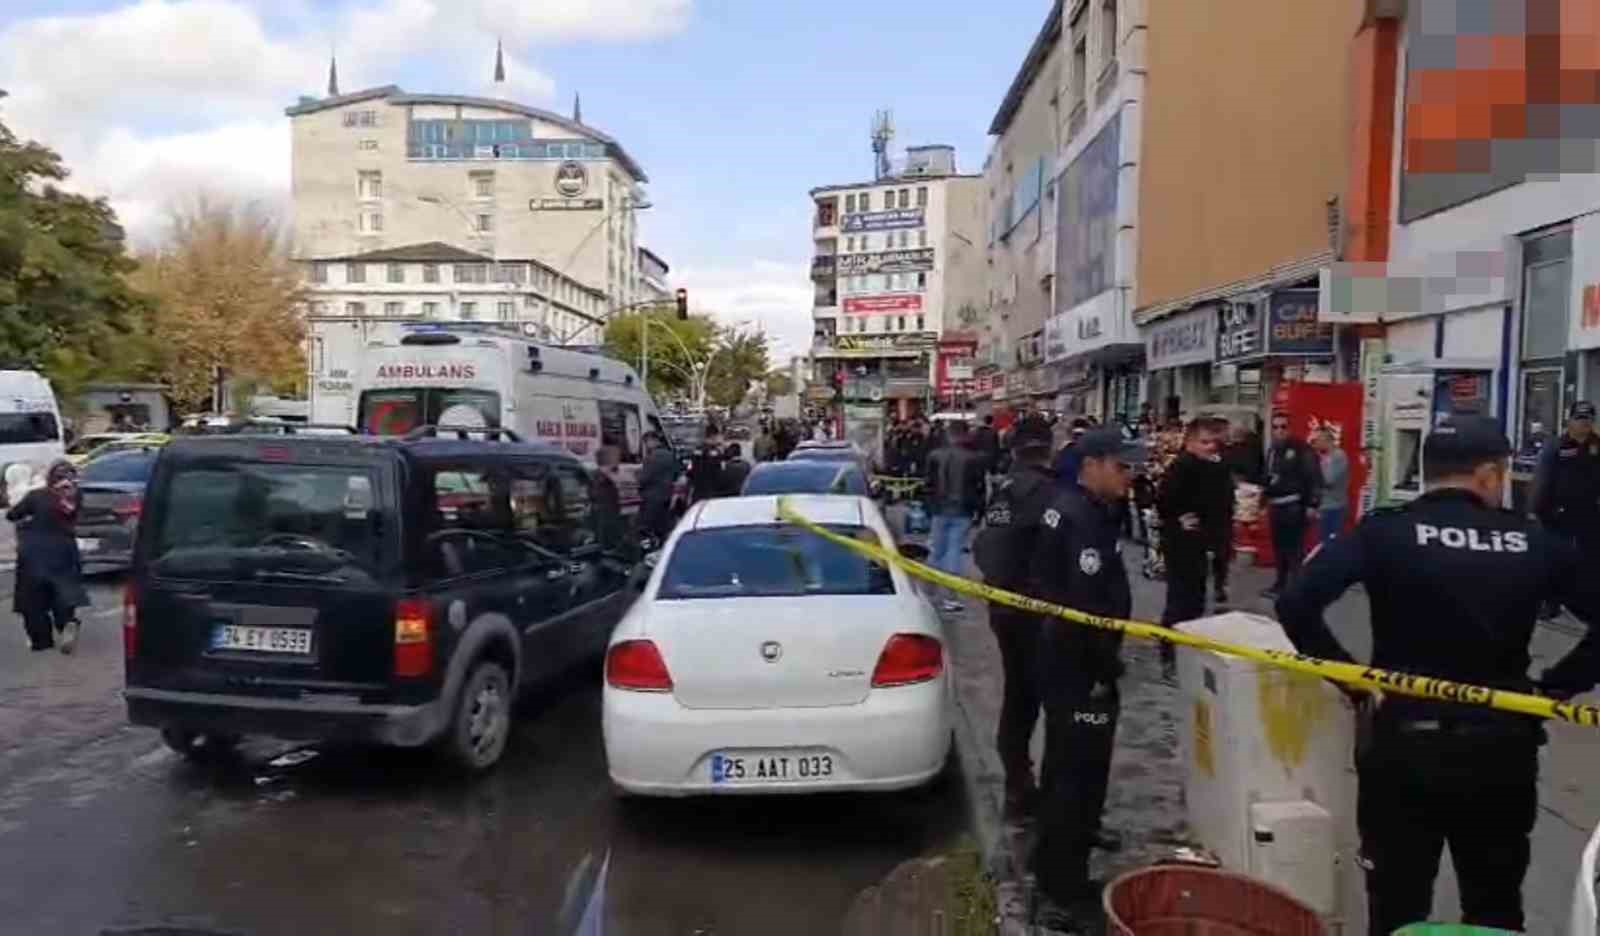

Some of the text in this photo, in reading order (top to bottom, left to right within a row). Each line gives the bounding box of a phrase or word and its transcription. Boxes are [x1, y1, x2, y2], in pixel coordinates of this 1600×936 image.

[376, 364, 476, 379] AMBULANS
[724, 755, 833, 779] 25 AAT 033
